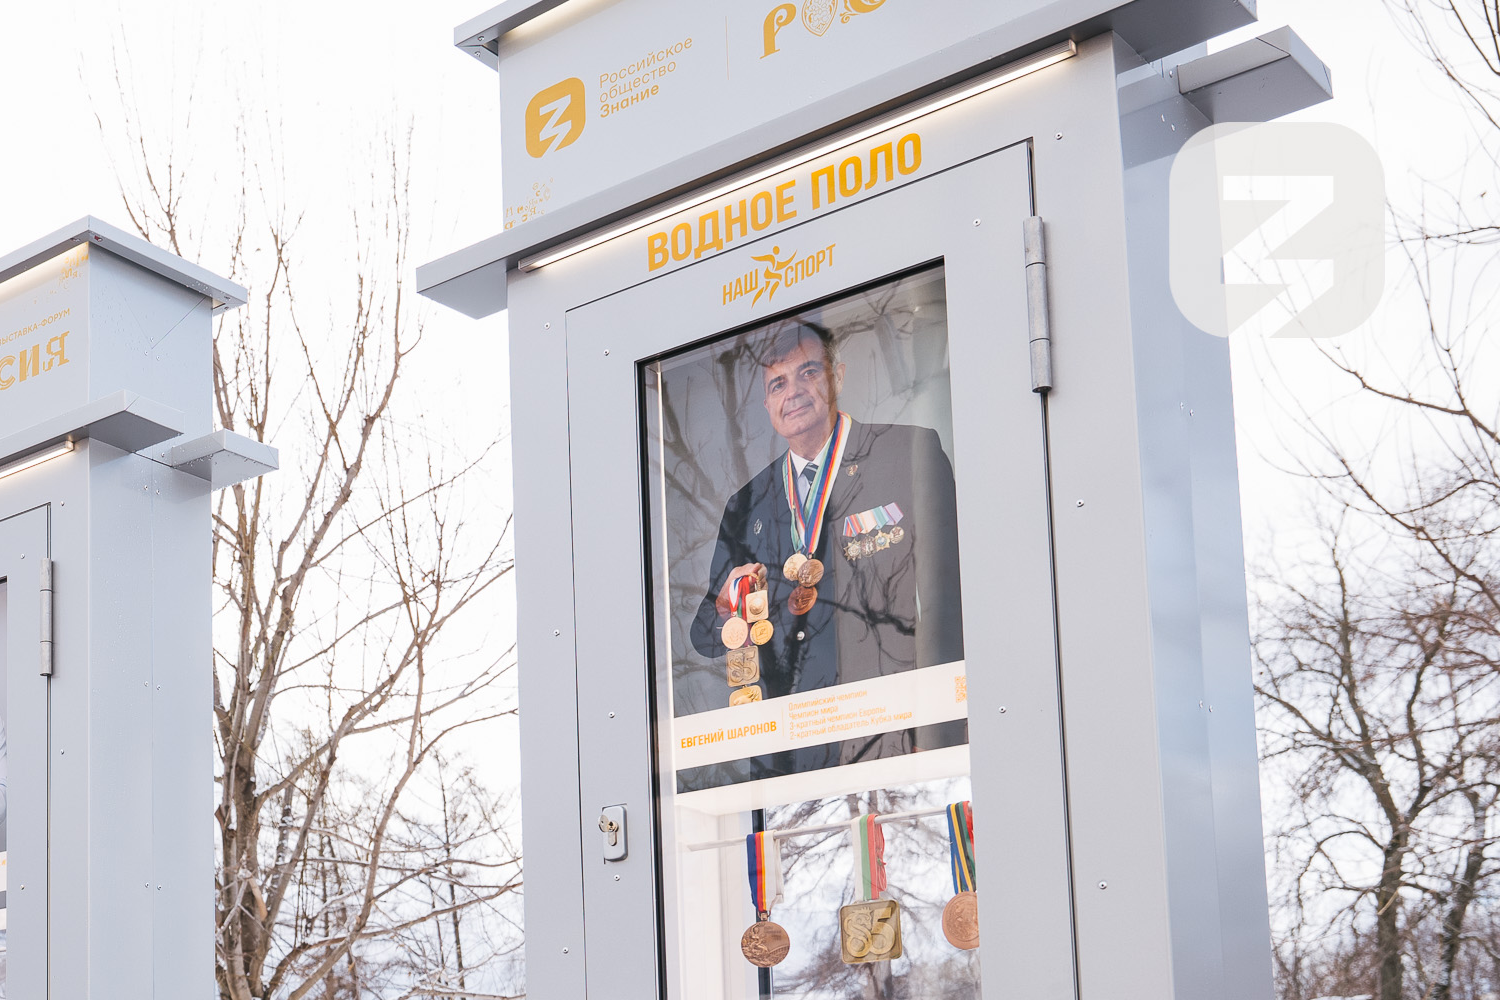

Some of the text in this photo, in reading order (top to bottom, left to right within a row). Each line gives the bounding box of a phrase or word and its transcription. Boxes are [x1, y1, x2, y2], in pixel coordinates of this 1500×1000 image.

[599, 37, 693, 89] Российское
[599, 61, 677, 103] общество
[600, 84, 659, 118] Знание
[647, 179, 797, 272] ВОДНОЕ
[810, 132, 922, 211] ПОЛО
[722, 243, 837, 307] НАШ СПОРТ
[788, 690, 868, 712] Олимпийский чемпион
[789, 705, 839, 721] Чемпион мира
[680, 720, 777, 749] ЕВГЕНИЙ ШАРОНОВ
[789, 706, 886, 731] 3-кратный чемпион Европы
[790, 710, 913, 740] 2-кратный обладатель Кубка мира
